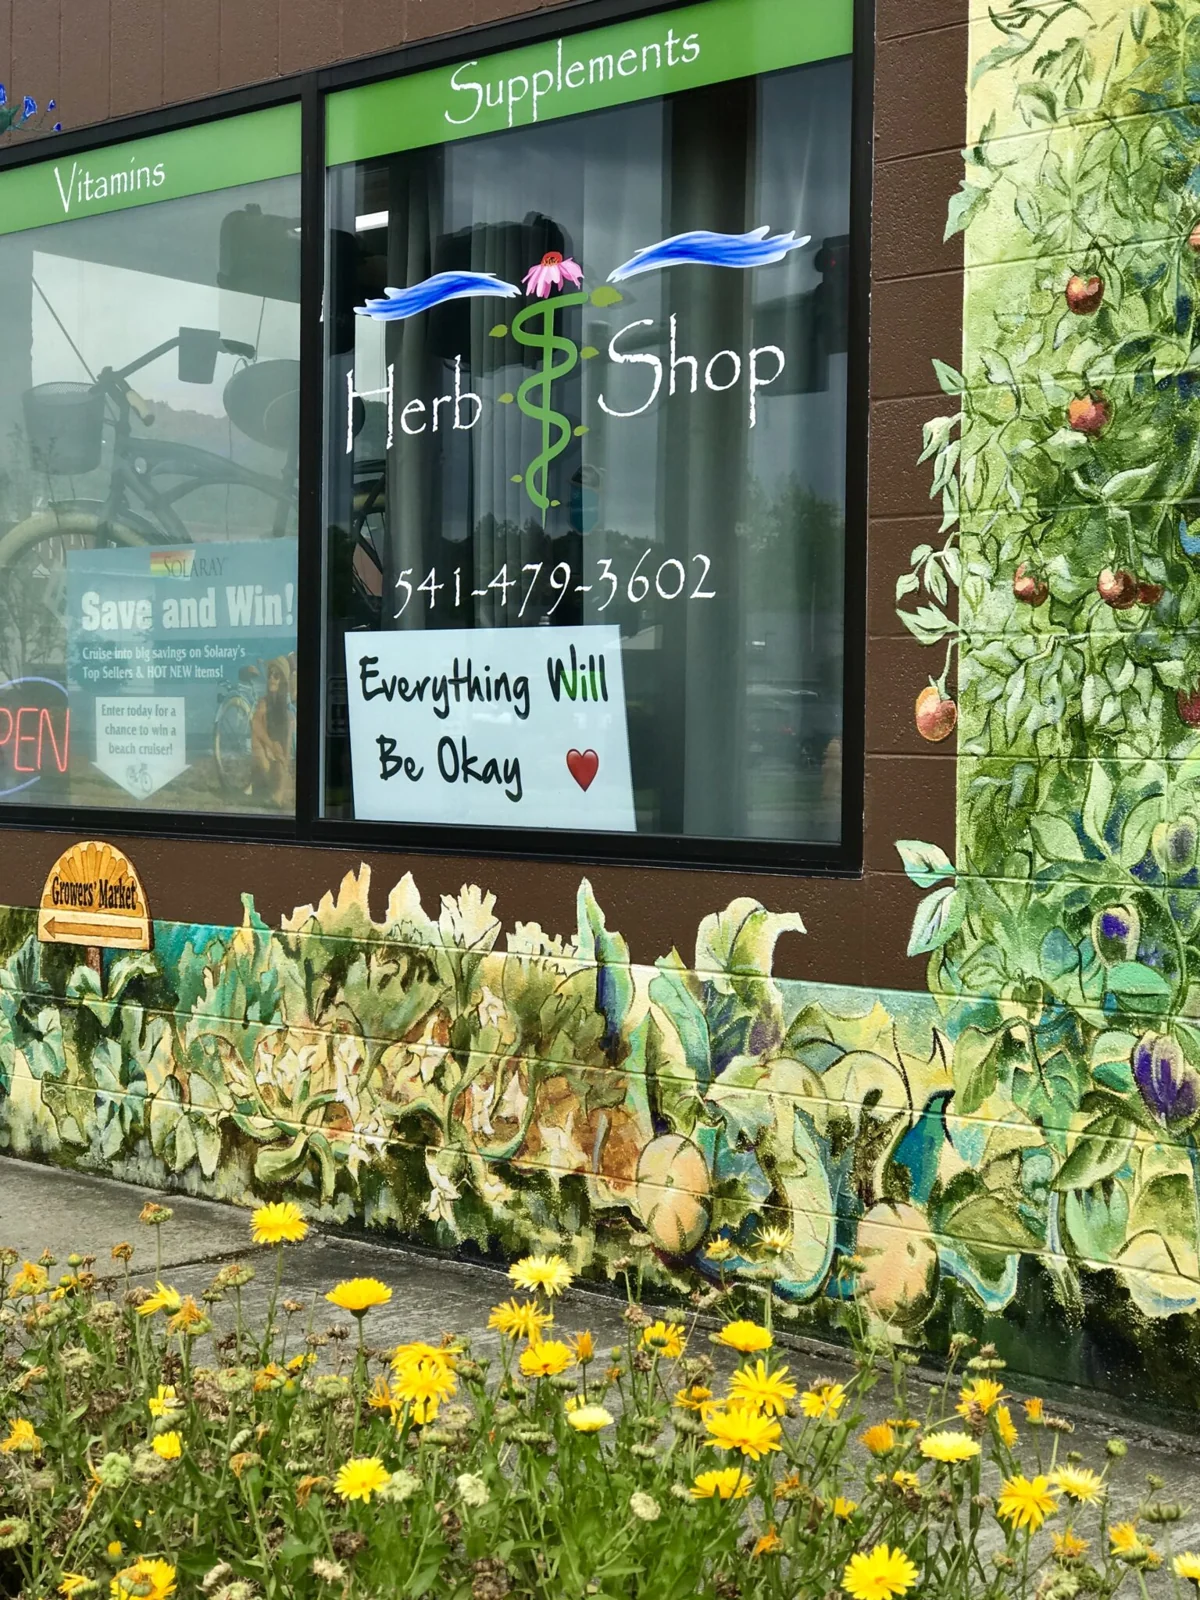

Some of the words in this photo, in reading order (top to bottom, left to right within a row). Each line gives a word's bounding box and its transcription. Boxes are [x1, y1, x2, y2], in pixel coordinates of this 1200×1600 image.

[444, 28, 700, 127] Supplements
[54, 156, 166, 213] Vitamins
[346, 354, 483, 454] Herb
[597, 313, 786, 428] Shop
[81, 591, 152, 631] Save
[162, 587, 217, 629] and
[226, 583, 294, 627] Win!
[393, 548, 716, 619] 541-479-3602
[82, 647, 112, 660] Cruise
[114, 647, 132, 660] into
[135, 646, 150, 662] big
[152, 645, 187, 662] savings
[189, 648, 201, 658] on
[204, 644, 246, 661] Solaray's
[82, 666, 99, 681] Top
[102, 665, 133, 679] Sellers
[135, 666, 144, 679] &
[147, 665, 167, 678] HOT
[170, 665, 192, 678] NEW
[195, 665, 224, 678] items!
[359, 655, 529, 719] Everything
[547, 644, 609, 702] Will
[101, 704, 125, 716] Enter
[127, 704, 153, 720] today
[155, 704, 168, 717] for
[170, 707, 177, 717] a
[105, 723, 137, 736] chance
[139, 725, 149, 736] to
[152, 724, 168, 736] win
[170, 727, 177, 736] a
[109, 742, 136, 754] beach
[138, 743, 173, 755] cruiser!
[375, 734, 424, 781] Be
[437, 735, 523, 802] Okay
[51, 876, 97, 907] Growers'
[98, 878, 138, 910] Market
